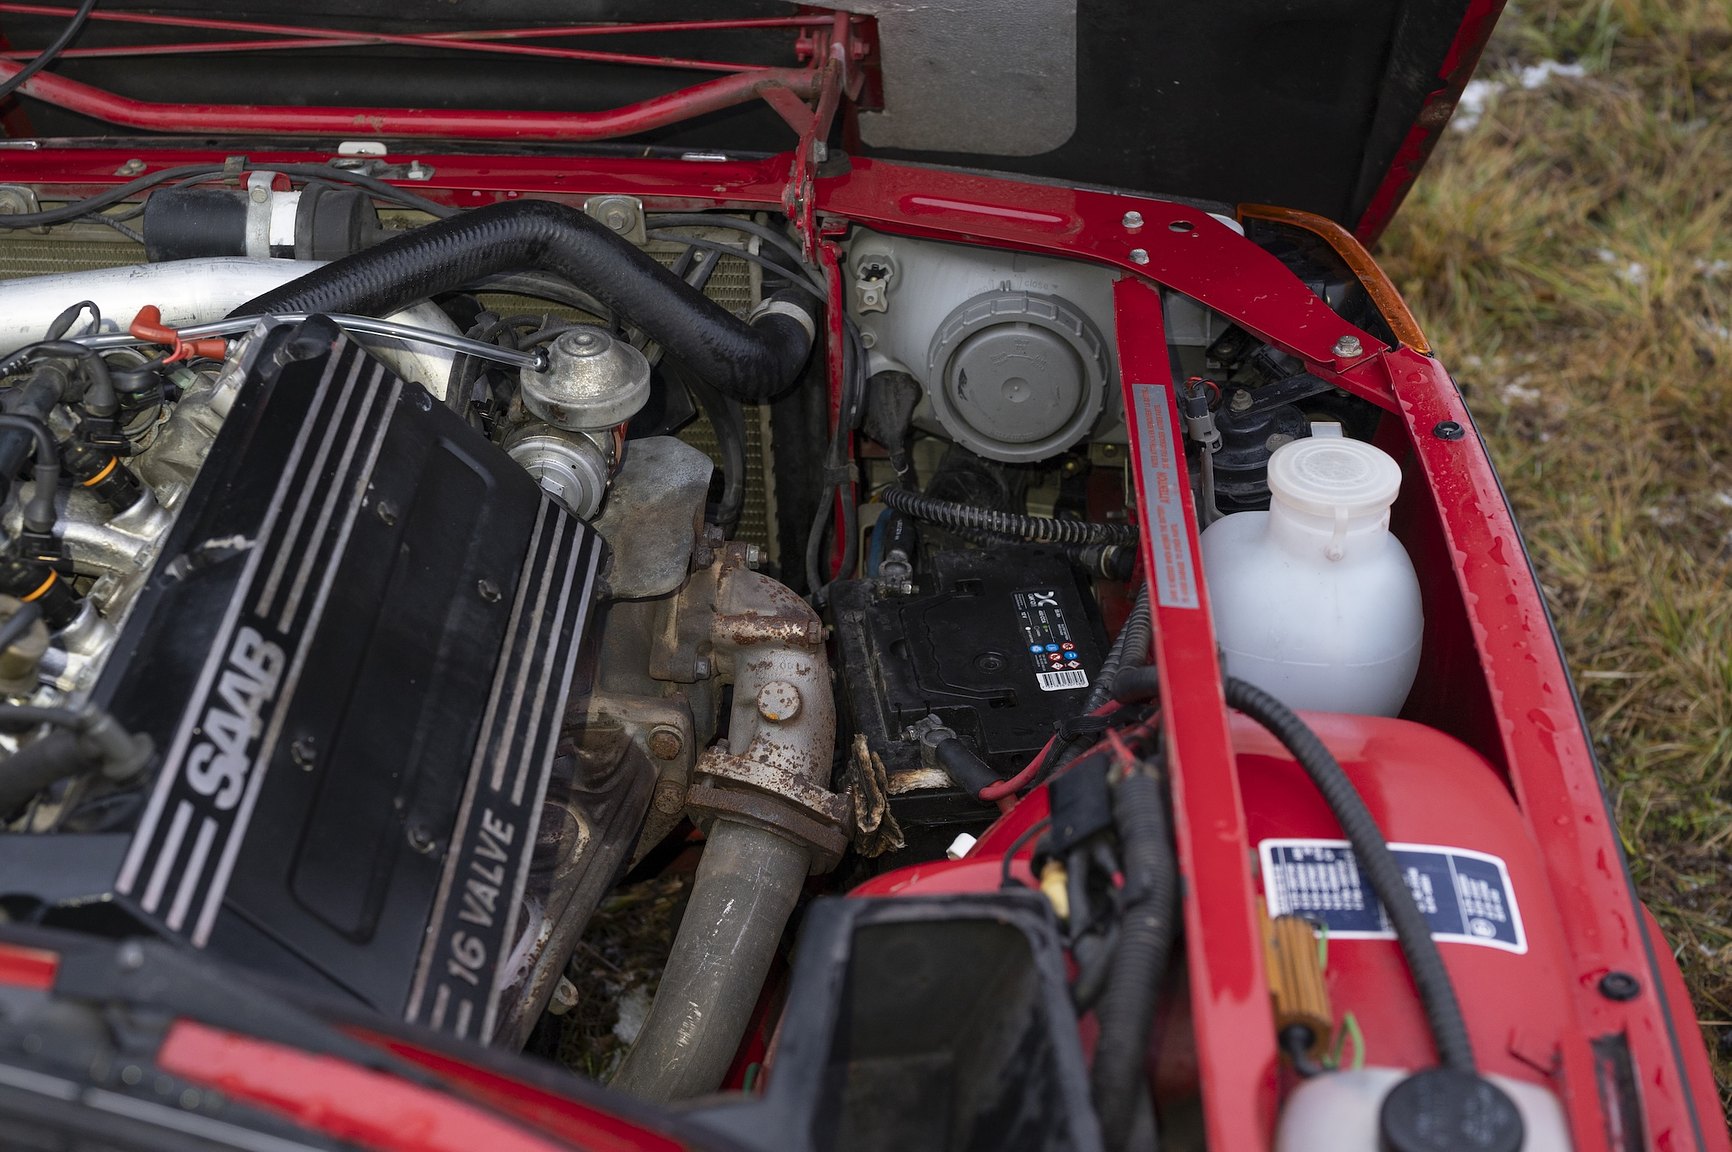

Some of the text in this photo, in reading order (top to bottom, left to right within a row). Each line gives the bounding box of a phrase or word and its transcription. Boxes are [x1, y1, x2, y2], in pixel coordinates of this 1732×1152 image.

[1024, 280, 1049, 290] close
[186, 627, 286, 810] SAAB
[448, 808, 515, 986] 16 VALVE
